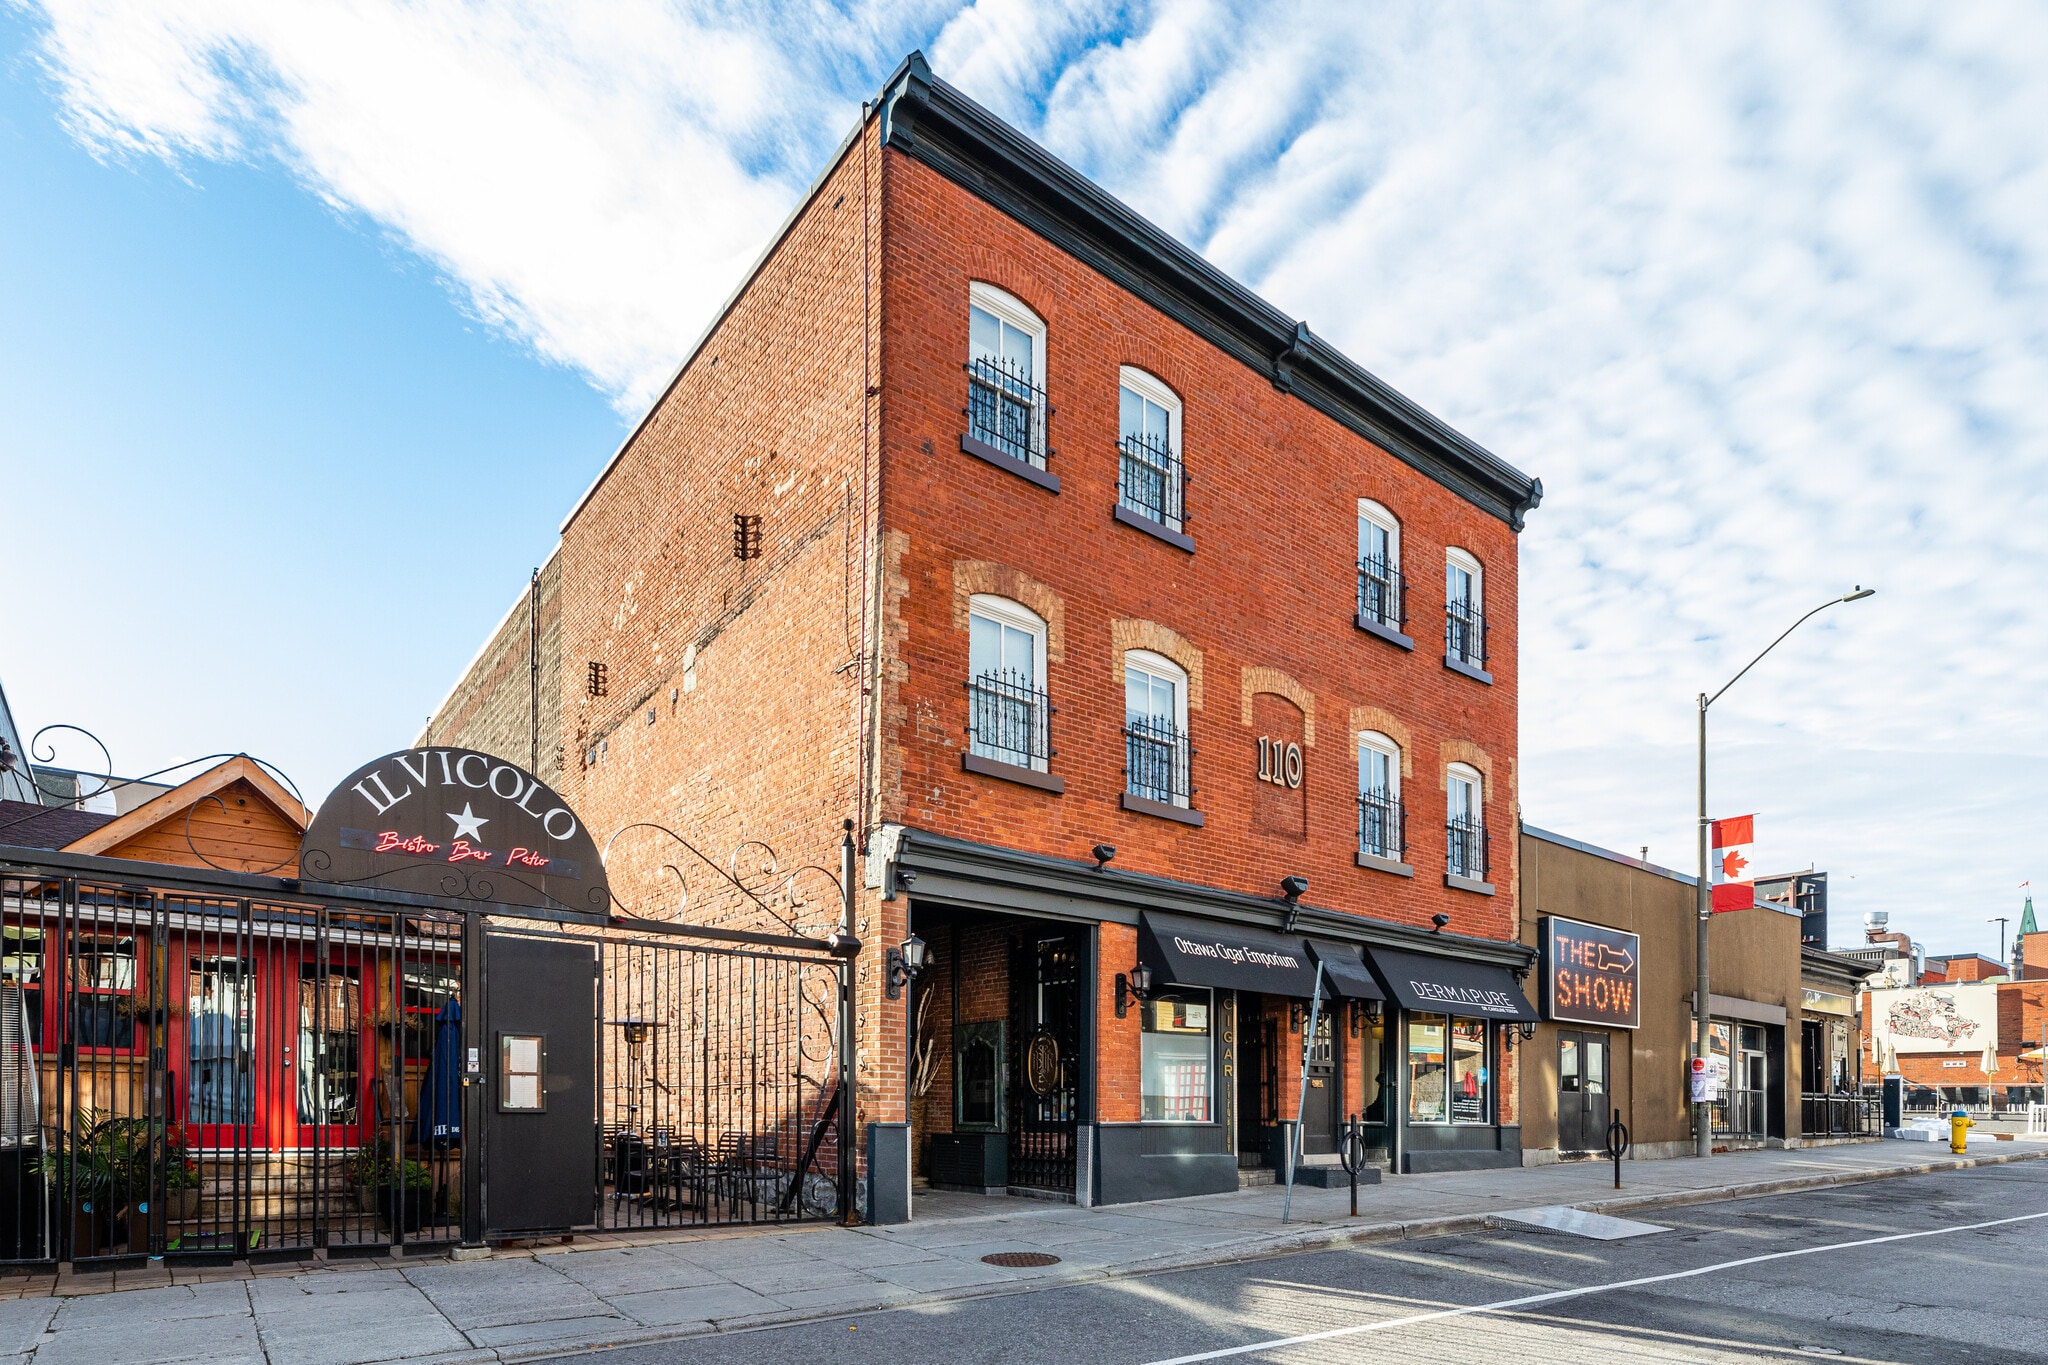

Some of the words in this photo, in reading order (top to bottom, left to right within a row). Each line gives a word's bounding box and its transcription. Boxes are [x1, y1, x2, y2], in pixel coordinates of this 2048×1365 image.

[1258, 735, 1303, 789] 110
[375, 830, 440, 854] Bistro
[447, 840, 492, 863] Bar
[505, 846, 550, 867] Patio
[1174, 936, 1218, 959] Ottawa
[1216, 942, 1246, 965] Cigar
[1244, 947, 1299, 969] Emporium
[1557, 935, 1596, 968] THE
[1410, 980, 1515, 1007] DERMAPURE
[1558, 968, 1633, 1015] SHOW
[1223, 998, 1234, 1077] CIGAR
